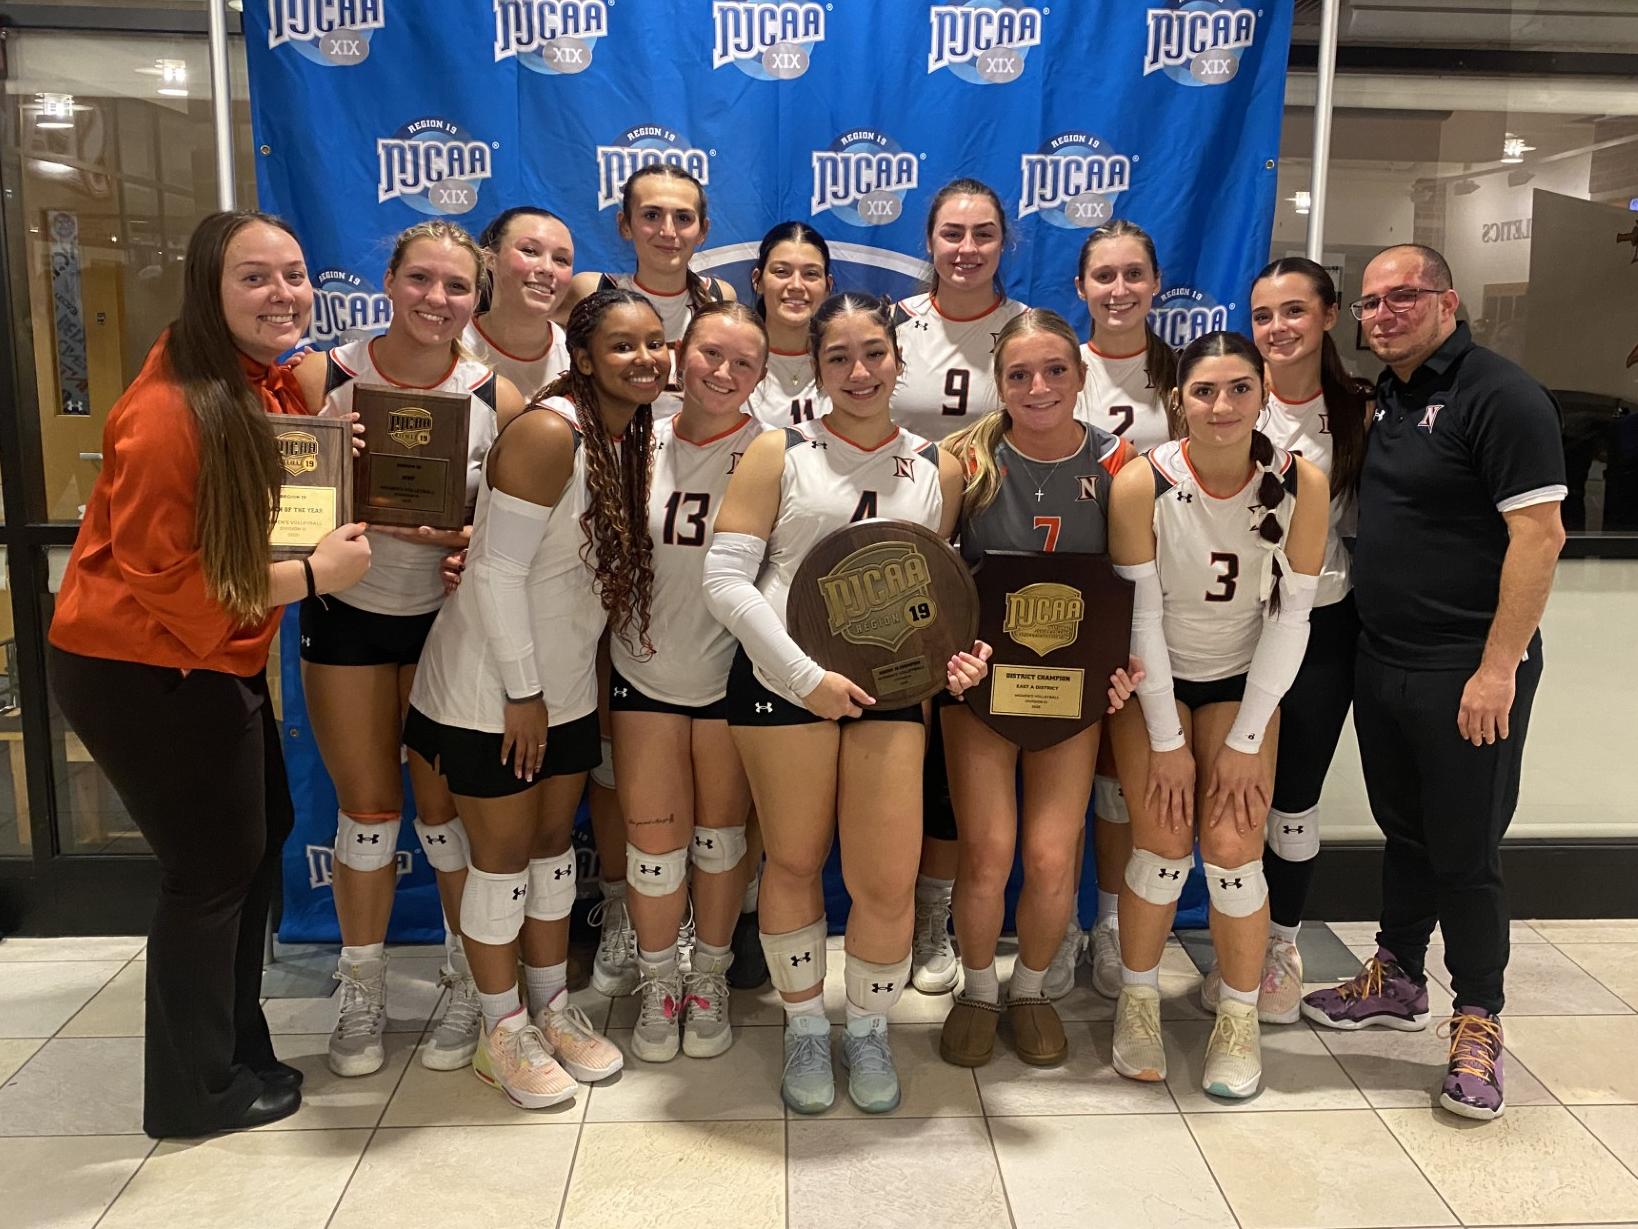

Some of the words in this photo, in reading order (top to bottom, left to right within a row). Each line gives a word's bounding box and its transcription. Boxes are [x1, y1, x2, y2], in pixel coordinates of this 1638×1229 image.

[493, 0, 608, 62] NJCAA
[713, 1, 825, 70] NJCAA
[928, 5, 1041, 74] NJCAA
[1144, 8, 1256, 76] NJCAA
[331, 40, 359, 56] XIX
[553, 48, 583, 63] XIX
[772, 53, 801, 69] XIX
[986, 58, 1015, 74] XIX
[1201, 59, 1230, 75] XIX
[407, 119, 443, 135] REGION
[445, 123, 458, 135] 19
[627, 127, 662, 141] REGION
[664, 130, 676, 142] 19
[841, 131, 875, 145] REGION
[876, 135, 887, 146] 19
[1051, 134, 1086, 148] REGION
[1087, 137, 1100, 149] 19
[376, 137, 492, 204] NJCAA
[811, 151, 918, 215] NJCAA
[1018, 153, 1131, 220] NJCAA
[439, 189, 468, 205] XIX
[867, 201, 893, 216] XIX
[1075, 202, 1104, 218] XIX
[348, 274, 360, 286] 19
[1160, 287, 1190, 301] REGION
[1191, 290, 1203, 301] 19
[311, 289, 394, 340] JCAA
[942, 368, 970, 416] 9
[1108, 405, 1134, 444] 2
[1417, 404, 1445, 434] N
[305, 460, 315, 468] 19
[893, 455, 915, 483] N
[1075, 475, 1099, 501] N
[662, 490, 711, 547] 13
[1033, 515, 1062, 552] 7
[1204, 551, 1239, 602] 3
[820, 554, 929, 634] NJCAA
[855, 613, 899, 634] REGION
[908, 602, 931, 622] 19
[1004, 593, 1085, 632] NJCAA
[1006, 673, 1036, 681] DISTRICT
[1037, 674, 1071, 682] CHAMPION
